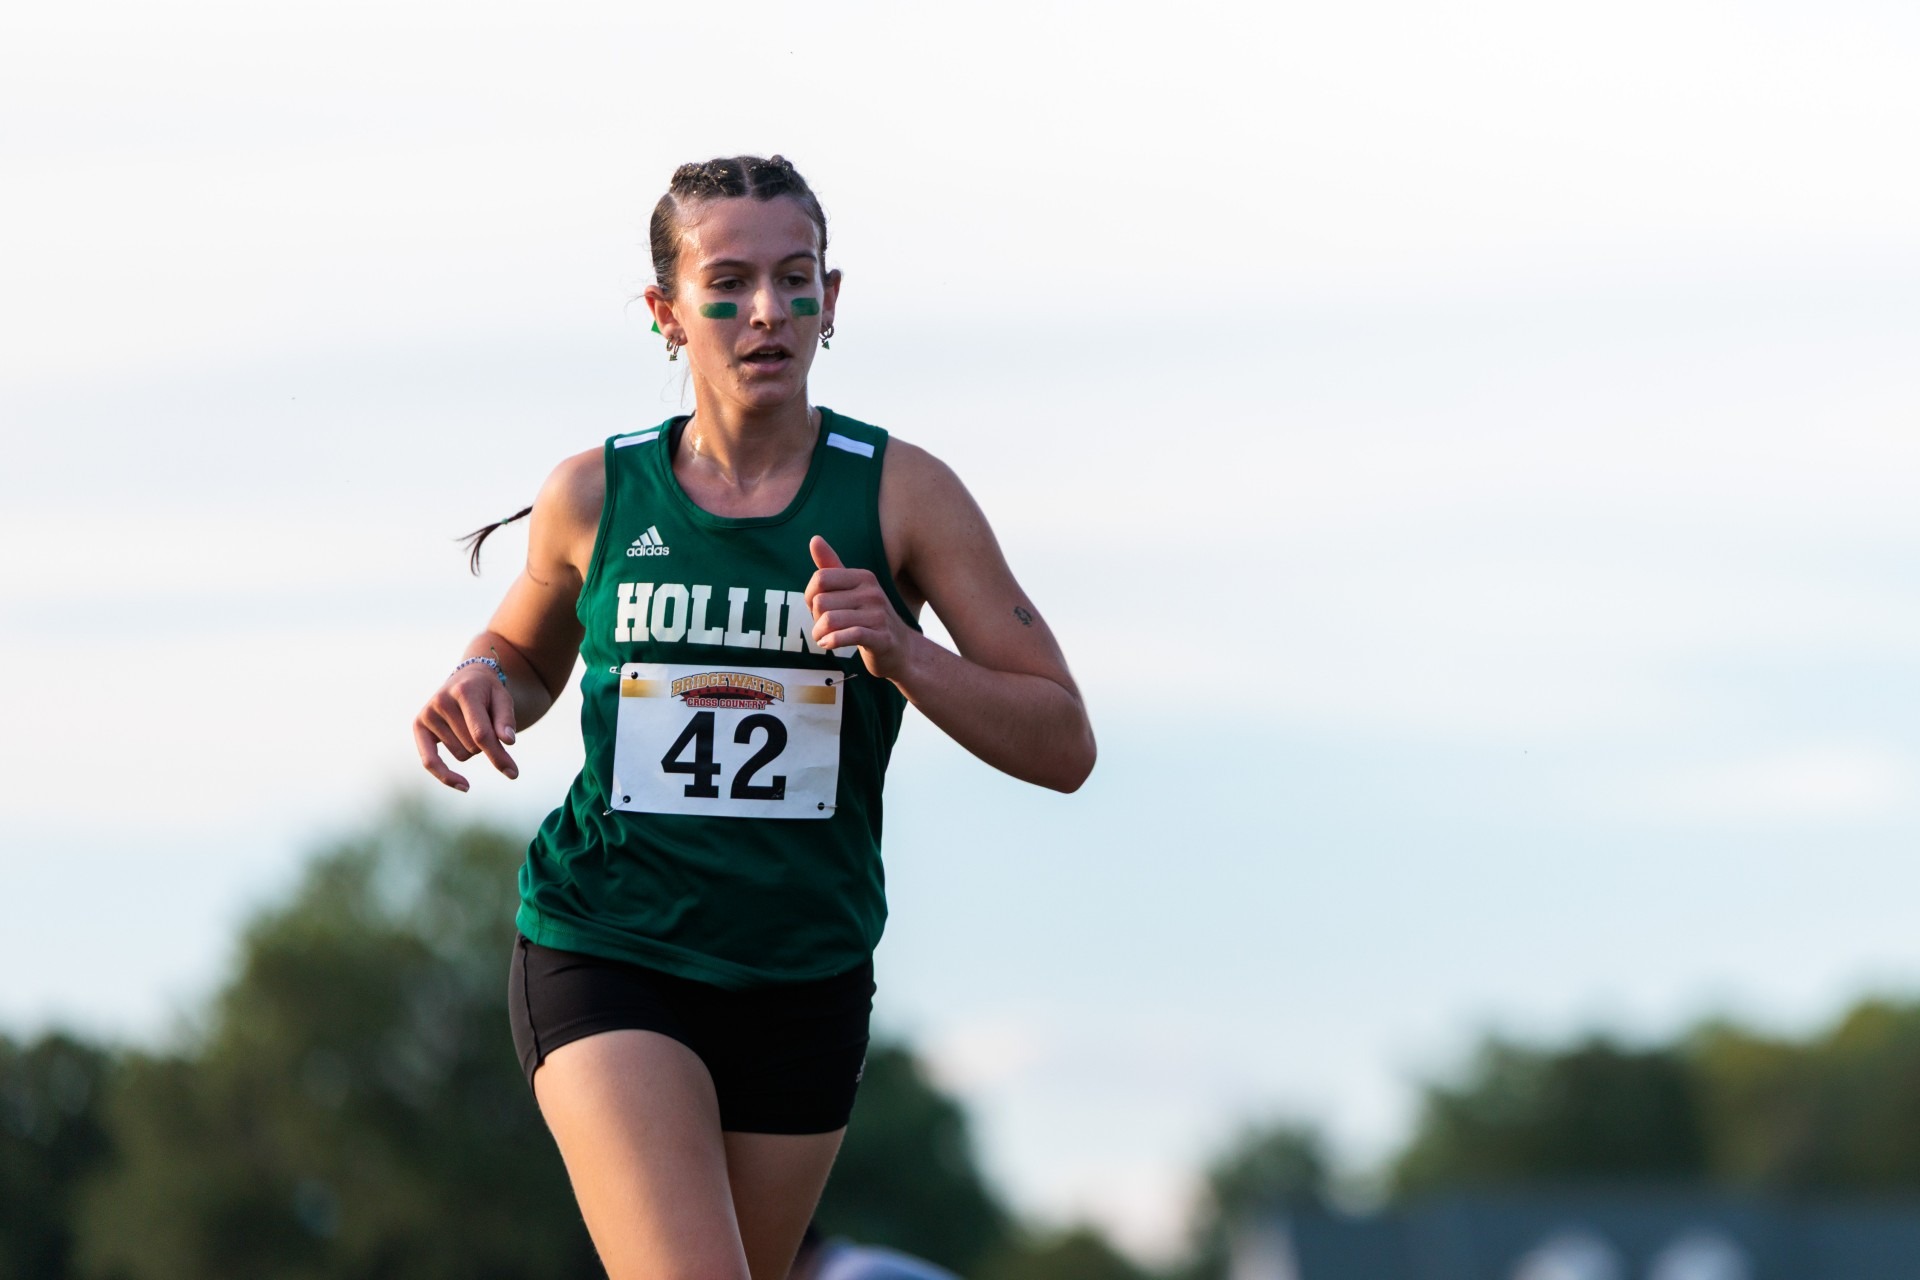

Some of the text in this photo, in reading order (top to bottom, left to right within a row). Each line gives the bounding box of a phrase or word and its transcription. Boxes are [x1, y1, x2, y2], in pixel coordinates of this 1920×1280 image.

[626, 544, 670, 557] adidas
[615, 582, 858, 659] HOLLIN
[671, 672, 784, 701] BRIDGEWATER
[687, 698, 767, 710] CROSS COUNTRY
[661, 711, 788, 800] 42
